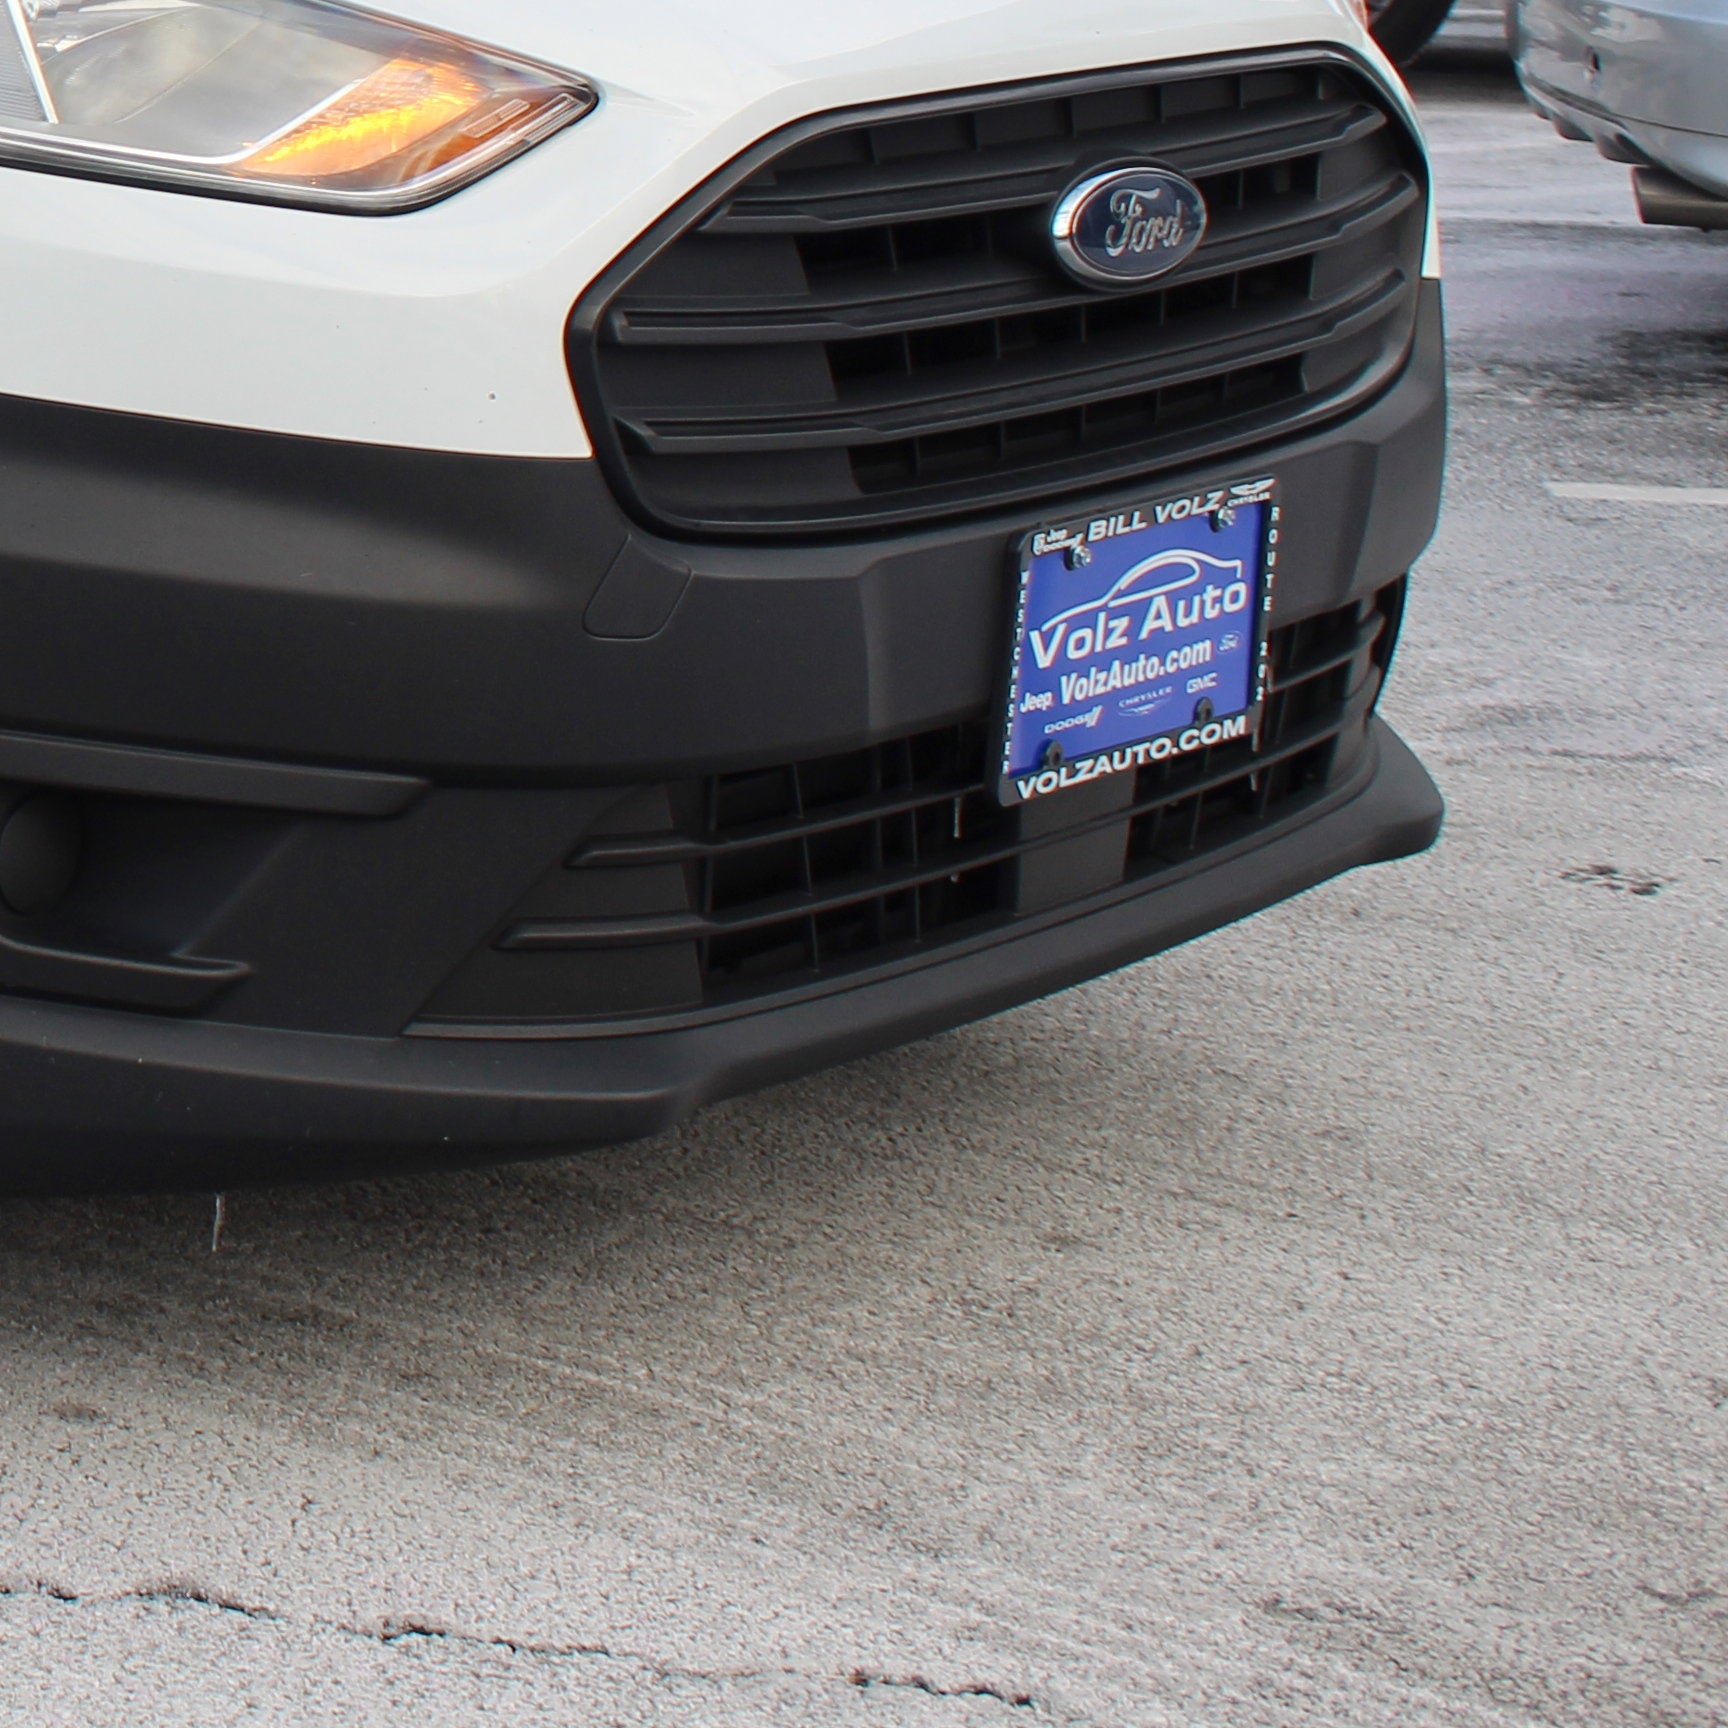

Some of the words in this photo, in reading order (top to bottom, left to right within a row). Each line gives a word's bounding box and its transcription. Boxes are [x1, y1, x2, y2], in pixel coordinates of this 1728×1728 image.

[1105, 187, 1184, 257] Ford
[1087, 511, 1148, 543] BILL
[1154, 490, 1225, 524] VOLZ
[1029, 610, 1131, 670] Volz
[1139, 581, 1248, 640] Auto
[1002, 570, 1029, 775] WESTCHESTER
[1019, 692, 1053, 714] Jeep
[1059, 639, 1213, 705] VolzAuto.com
[1118, 686, 1174, 708] CHRYSLER
[1186, 672, 1219, 695] GMC
[1016, 715, 1248, 801] VOLZAUTO.COM
